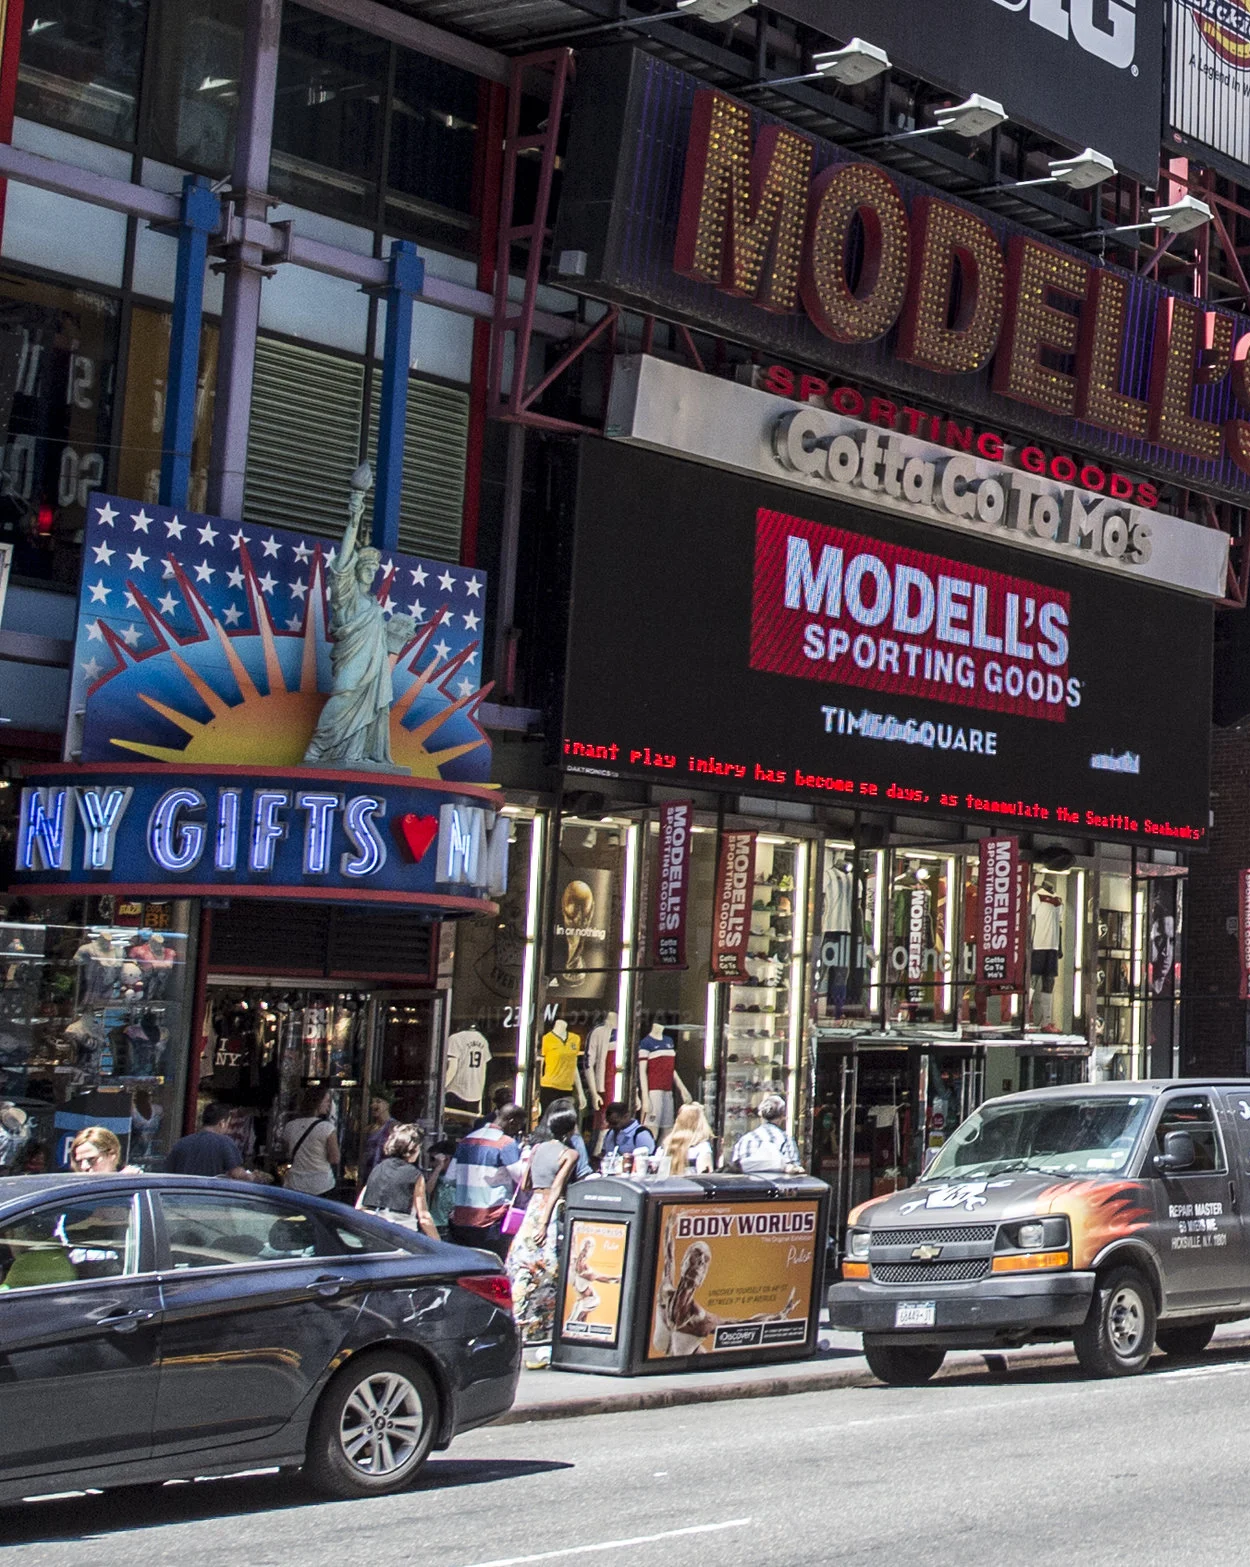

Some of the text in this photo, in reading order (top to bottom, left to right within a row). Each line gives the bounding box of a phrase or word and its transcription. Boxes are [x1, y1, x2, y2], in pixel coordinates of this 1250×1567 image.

[1198, 60, 1231, 85] Legend
[766, 365, 1159, 509] SPORTING GOODS
[1003, 470, 1059, 540] To
[1069, 495, 1152, 564] Mo's
[784, 535, 1070, 666] MODELL'S
[803, 624, 1082, 708] SPORTING GOODS
[630, 748, 677, 768] play
[754, 763, 787, 784] has
[795, 769, 854, 793] become
[940, 793, 958, 807] as
[1056, 806, 1080, 823] the
[1085, 810, 1139, 832] Seattle
[17, 786, 387, 879] NY GIFTS
[661, 807, 674, 878] SPORTING
[666, 805, 688, 931] MODELL'S
[723, 835, 736, 900] SPORTING
[725, 835, 750, 947] MODELL'S
[983, 842, 996, 950] SPORTING GOODS
[992, 841, 1011, 950] MODELL'S
[215, 1052, 241, 1067] NY
[677, 1213, 815, 1238] BODY WORLDS
[1169, 1202, 1222, 1217] REPAIR MASTER
[719, 1331, 756, 1341] Discovery
